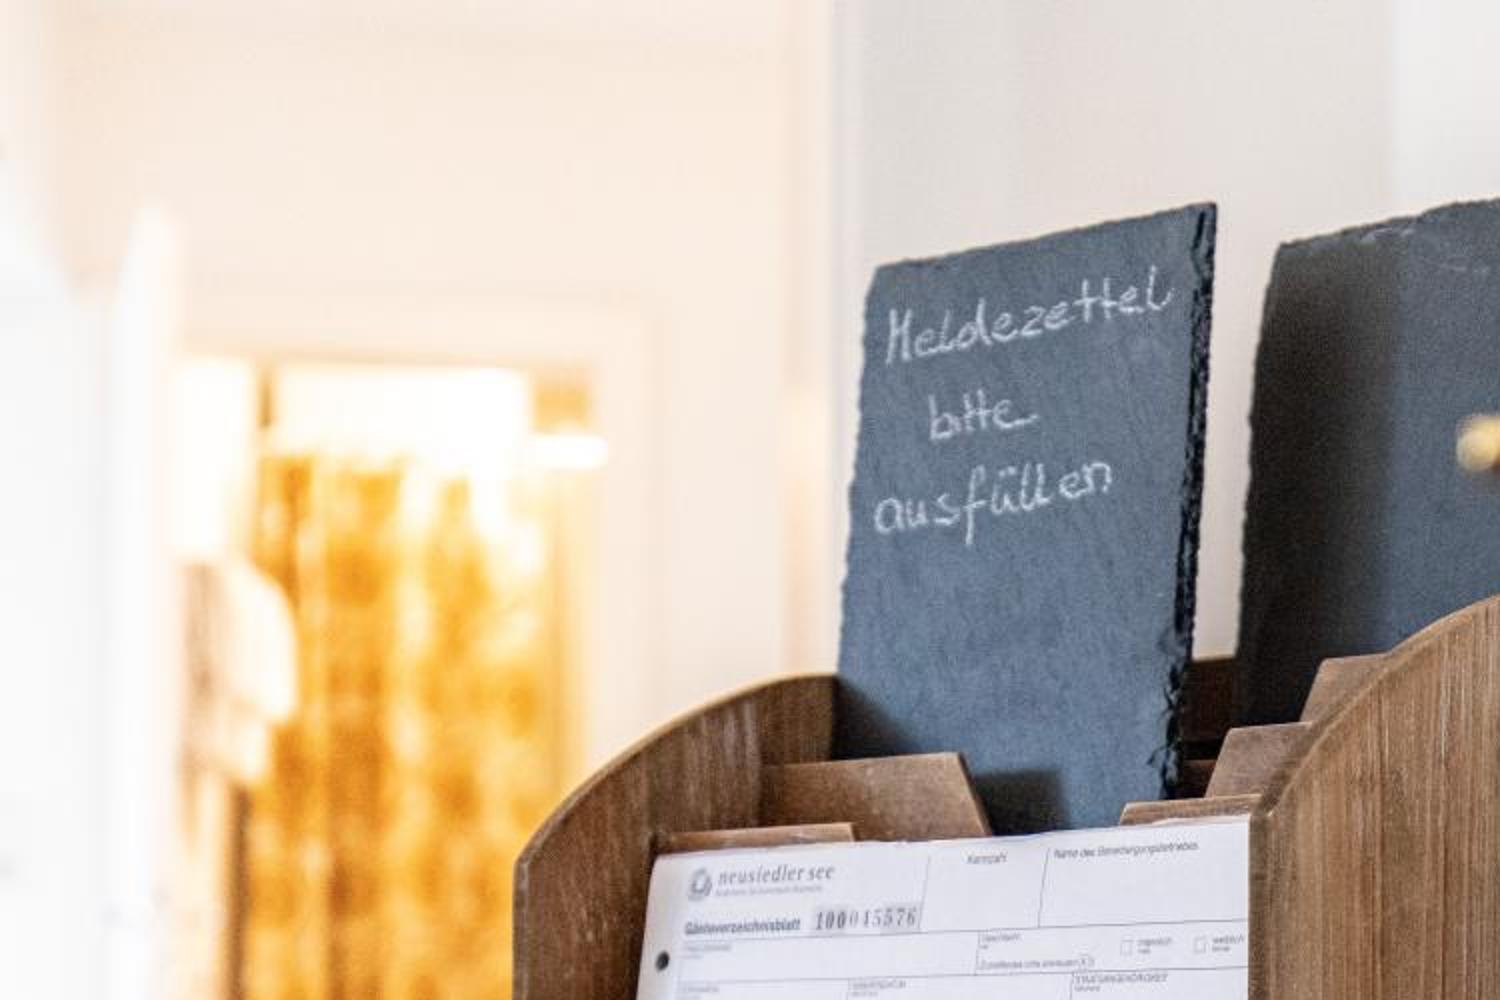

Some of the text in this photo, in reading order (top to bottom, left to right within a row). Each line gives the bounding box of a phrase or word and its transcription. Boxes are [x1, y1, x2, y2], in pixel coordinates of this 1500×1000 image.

[885, 264, 1175, 366] Meldezettel
[928, 388, 1040, 441] bitte
[873, 461, 1113, 547] ausfüllen
[717, 863, 836, 886] neusiedler see
